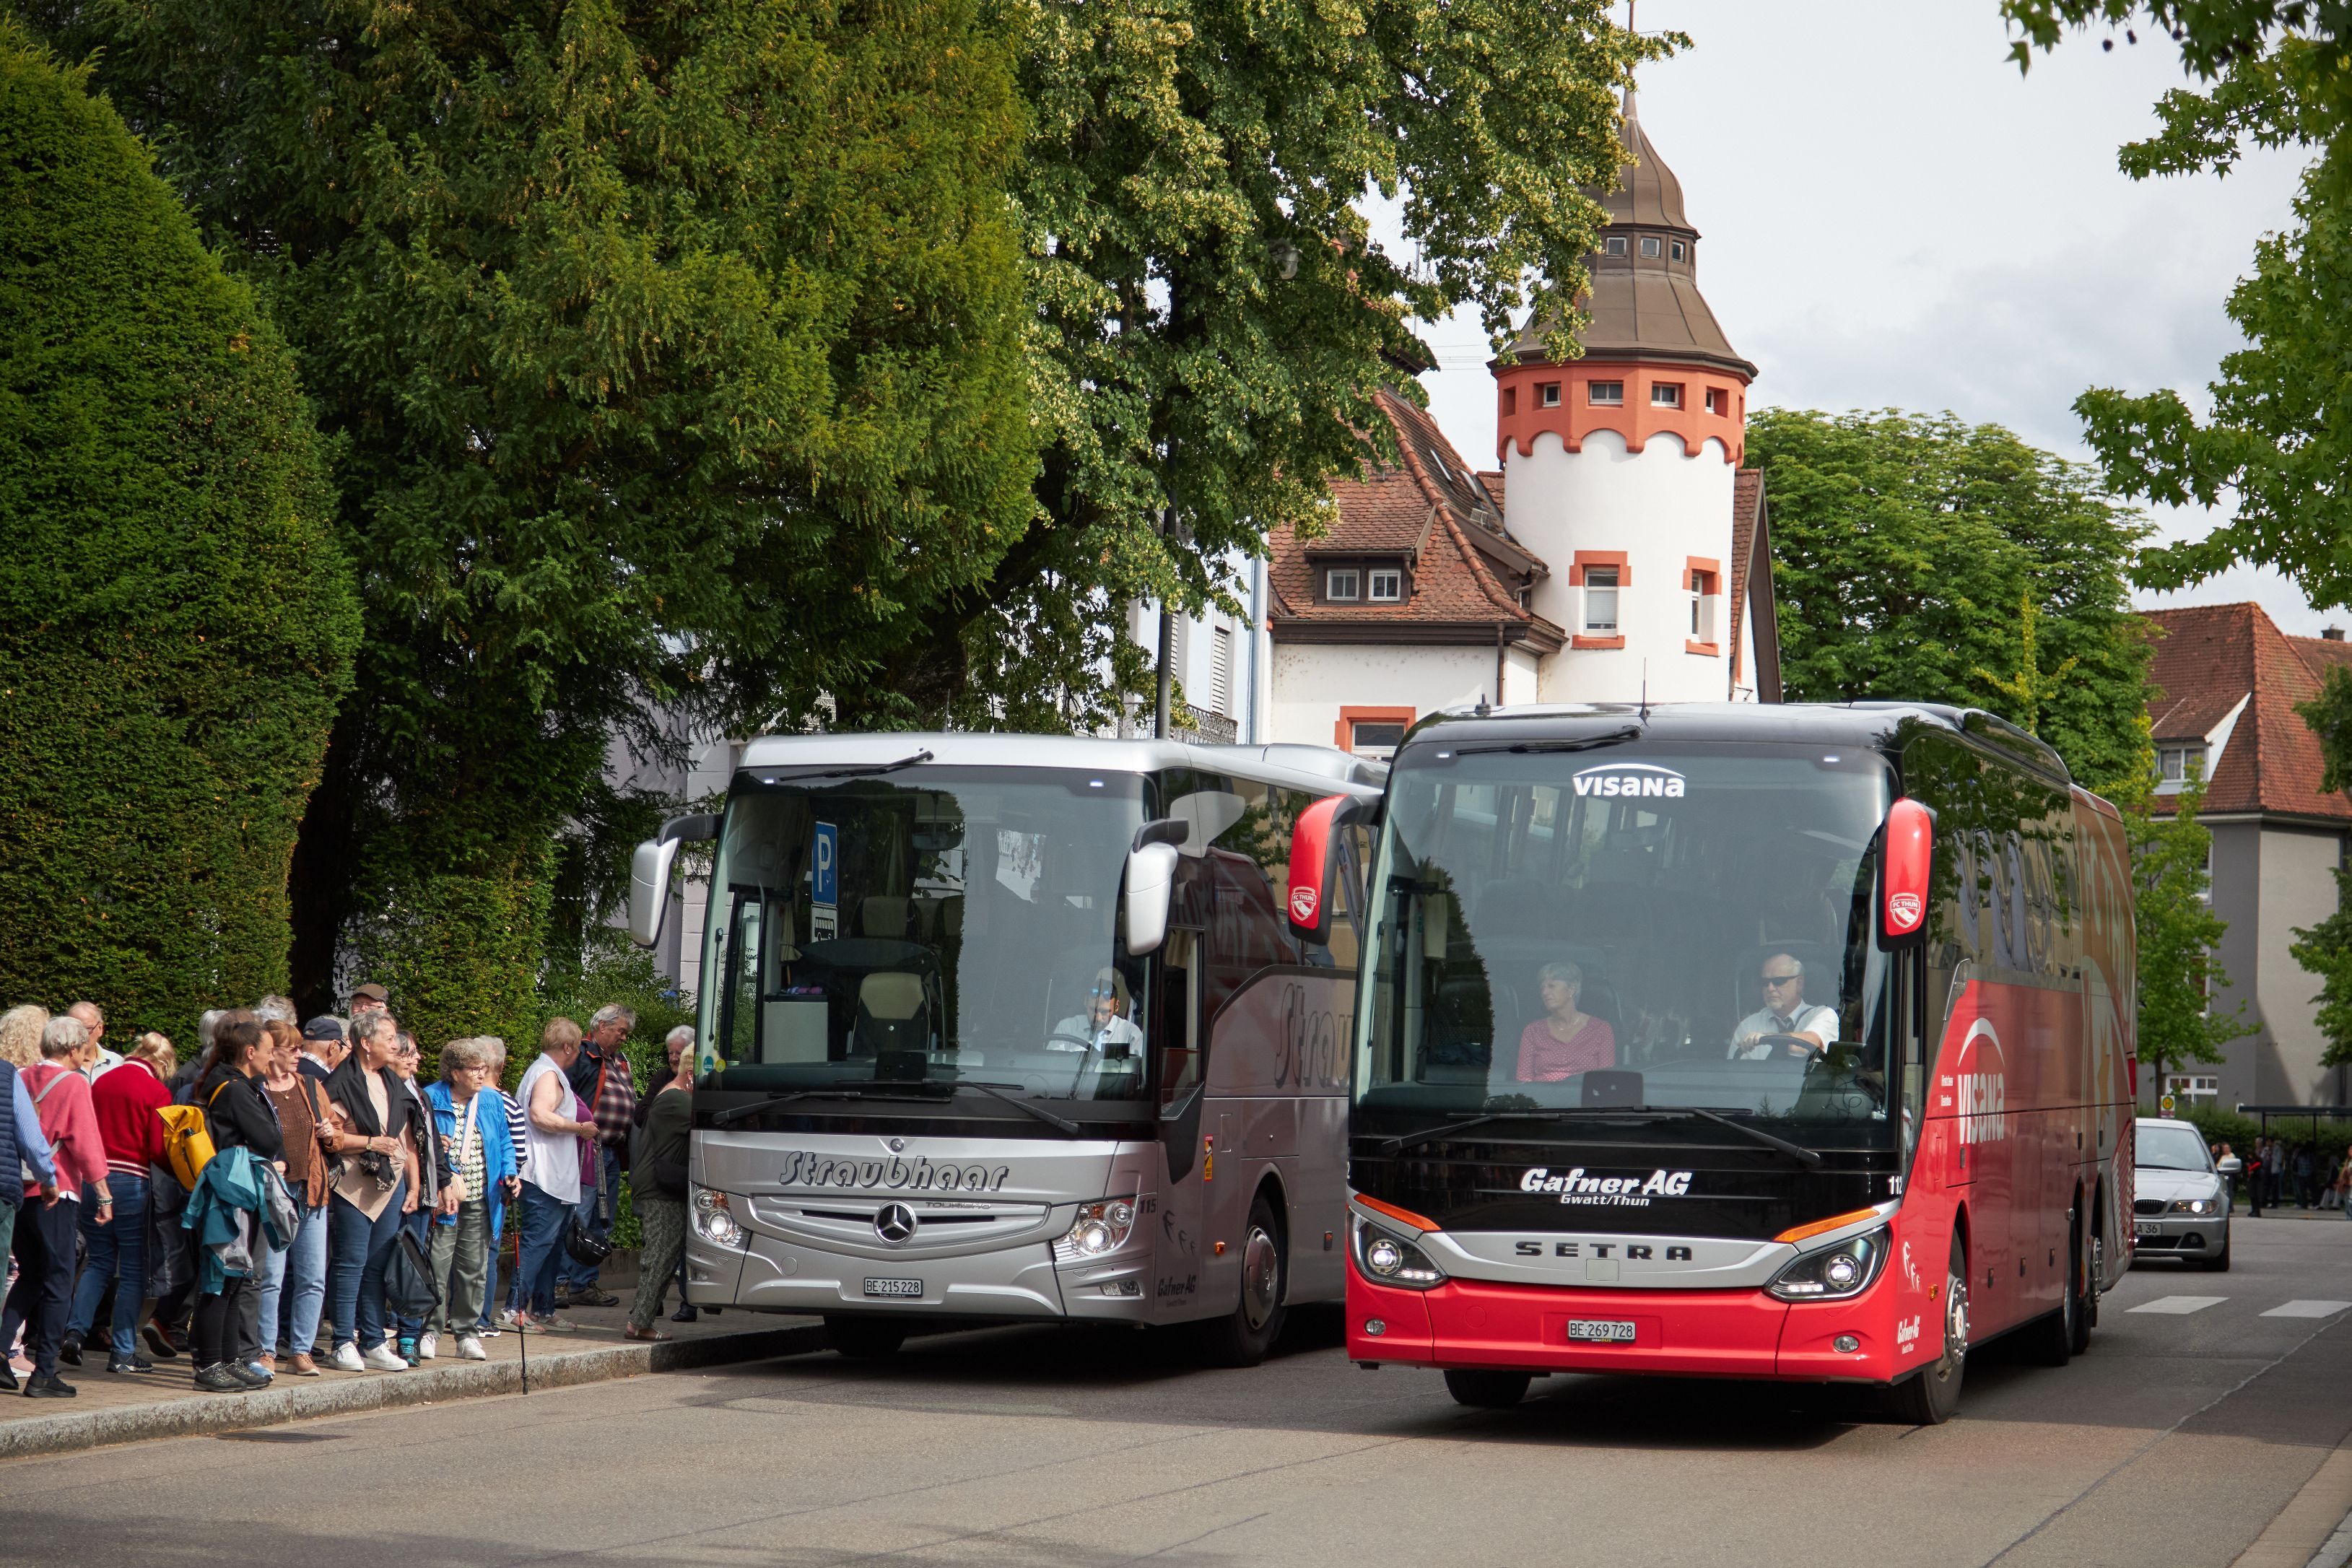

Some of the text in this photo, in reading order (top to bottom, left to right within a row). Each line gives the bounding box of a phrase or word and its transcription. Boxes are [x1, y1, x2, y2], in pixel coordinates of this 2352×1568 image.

[817, 833, 832, 893] P
[778, 1151, 1010, 1192] Straubhaar
[1520, 1168, 1692, 1195] Gafner AG
[925, 1201, 992, 1210] TOURISMO
[1140, 1199, 1157, 1214] 115
[1560, 1194, 1650, 1207] Gwatt/Thun
[2146, 1224, 2158, 1234] 36
[1515, 1241, 1692, 1261] SETRA
[1157, 1273, 1197, 1298] Gafner AG
[1912, 1315, 1921, 1340] AG
